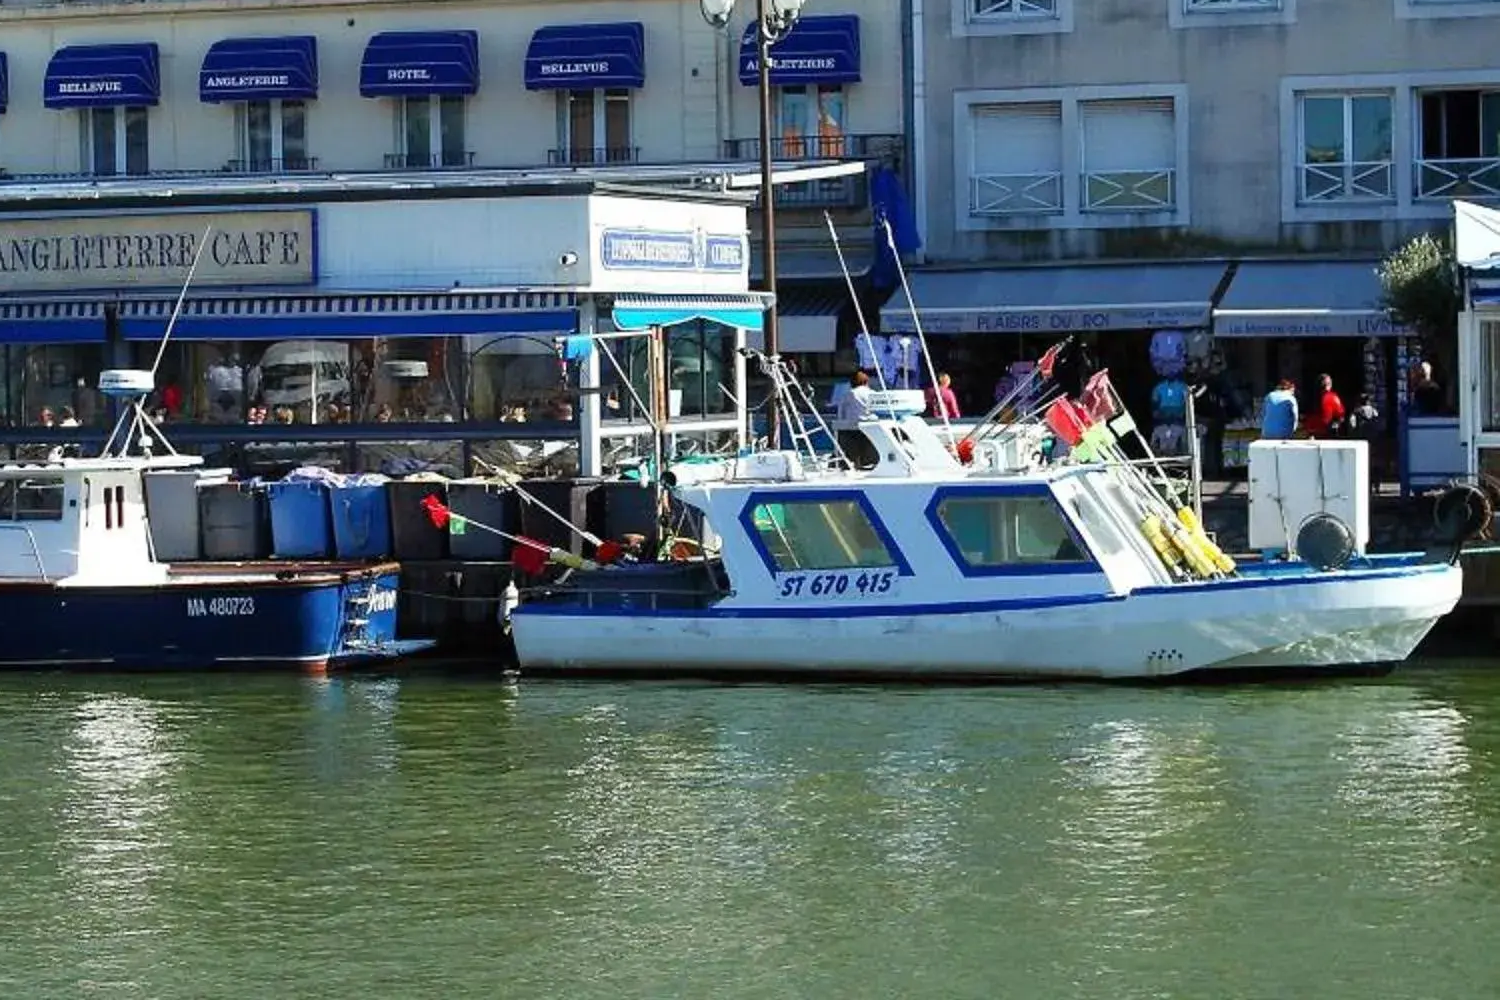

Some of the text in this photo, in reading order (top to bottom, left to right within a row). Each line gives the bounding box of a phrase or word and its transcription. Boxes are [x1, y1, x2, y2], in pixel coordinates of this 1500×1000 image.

[541, 61, 610, 74] BELLEVUE
[746, 57, 836, 71] ALETERRE
[206, 74, 289, 88] ANGLETERRE
[386, 68, 431, 80] HOTEL
[59, 81, 122, 94] BELLEVUE
[211, 230, 300, 269] CAFE
[781, 571, 893, 597] ST 670 415
[187, 596, 255, 617] MA 480723
